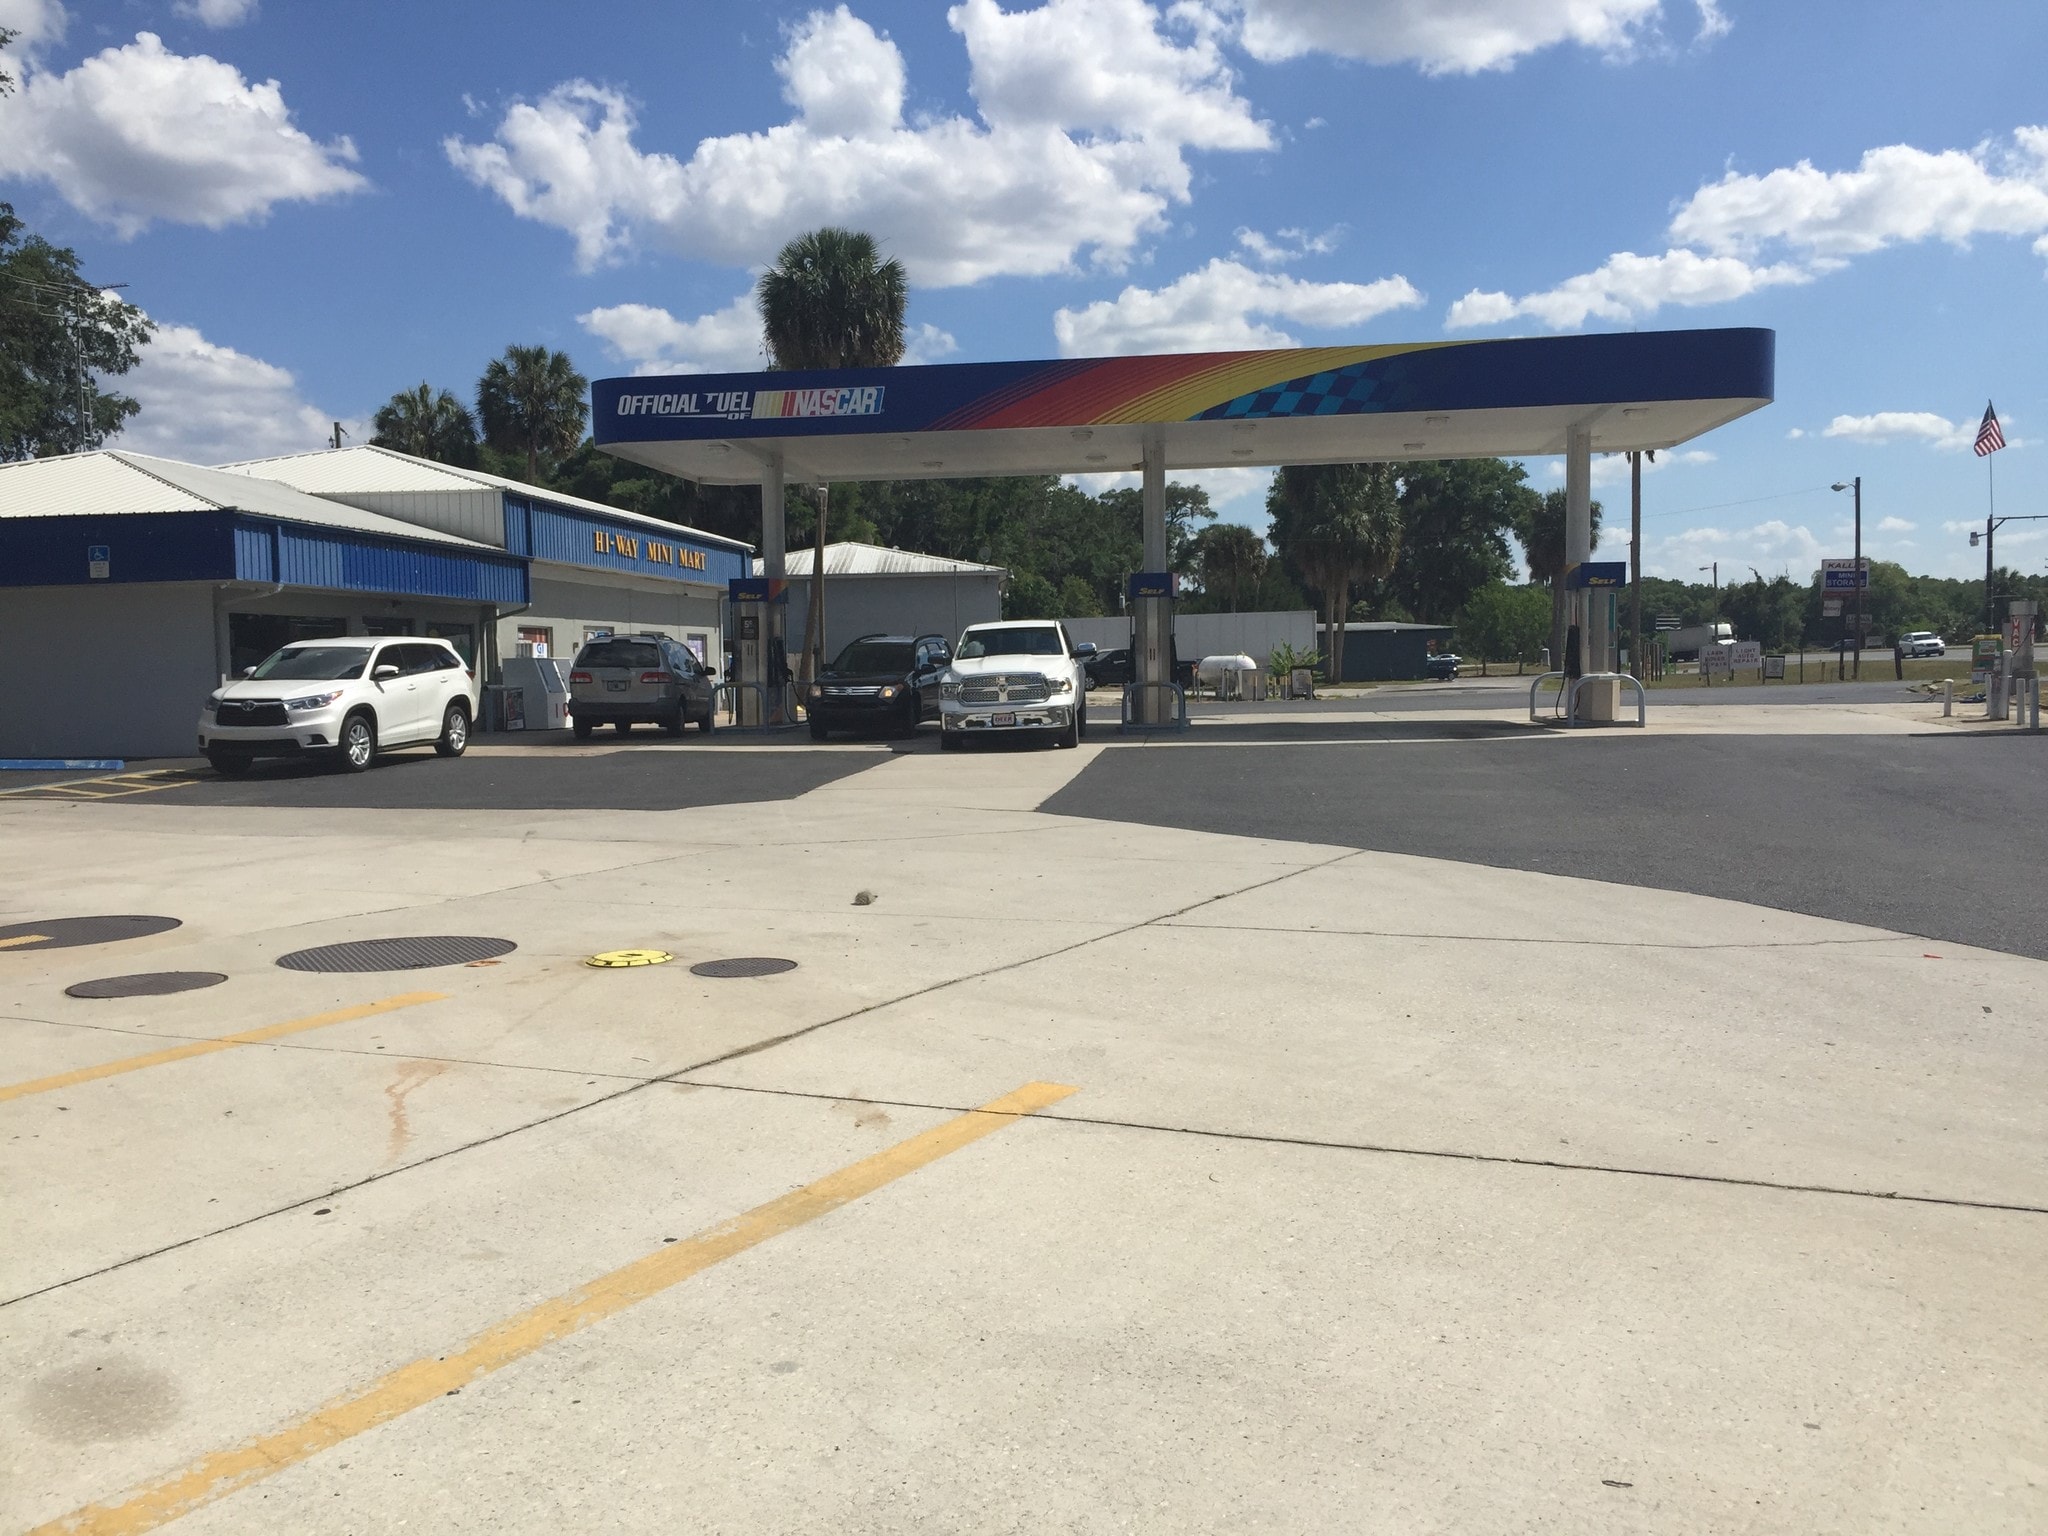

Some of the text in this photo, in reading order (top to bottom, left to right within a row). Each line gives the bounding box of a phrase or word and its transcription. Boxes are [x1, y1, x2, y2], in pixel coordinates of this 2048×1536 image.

[617, 393, 700, 416] OFFICIAL
[796, 387, 879, 416] NASCAR
[726, 412, 751, 421] OF
[595, 531, 706, 571] HI-WAY MINI MART
[1826, 579, 1866, 587] STORAE
[2012, 618, 2020, 647] VAC
